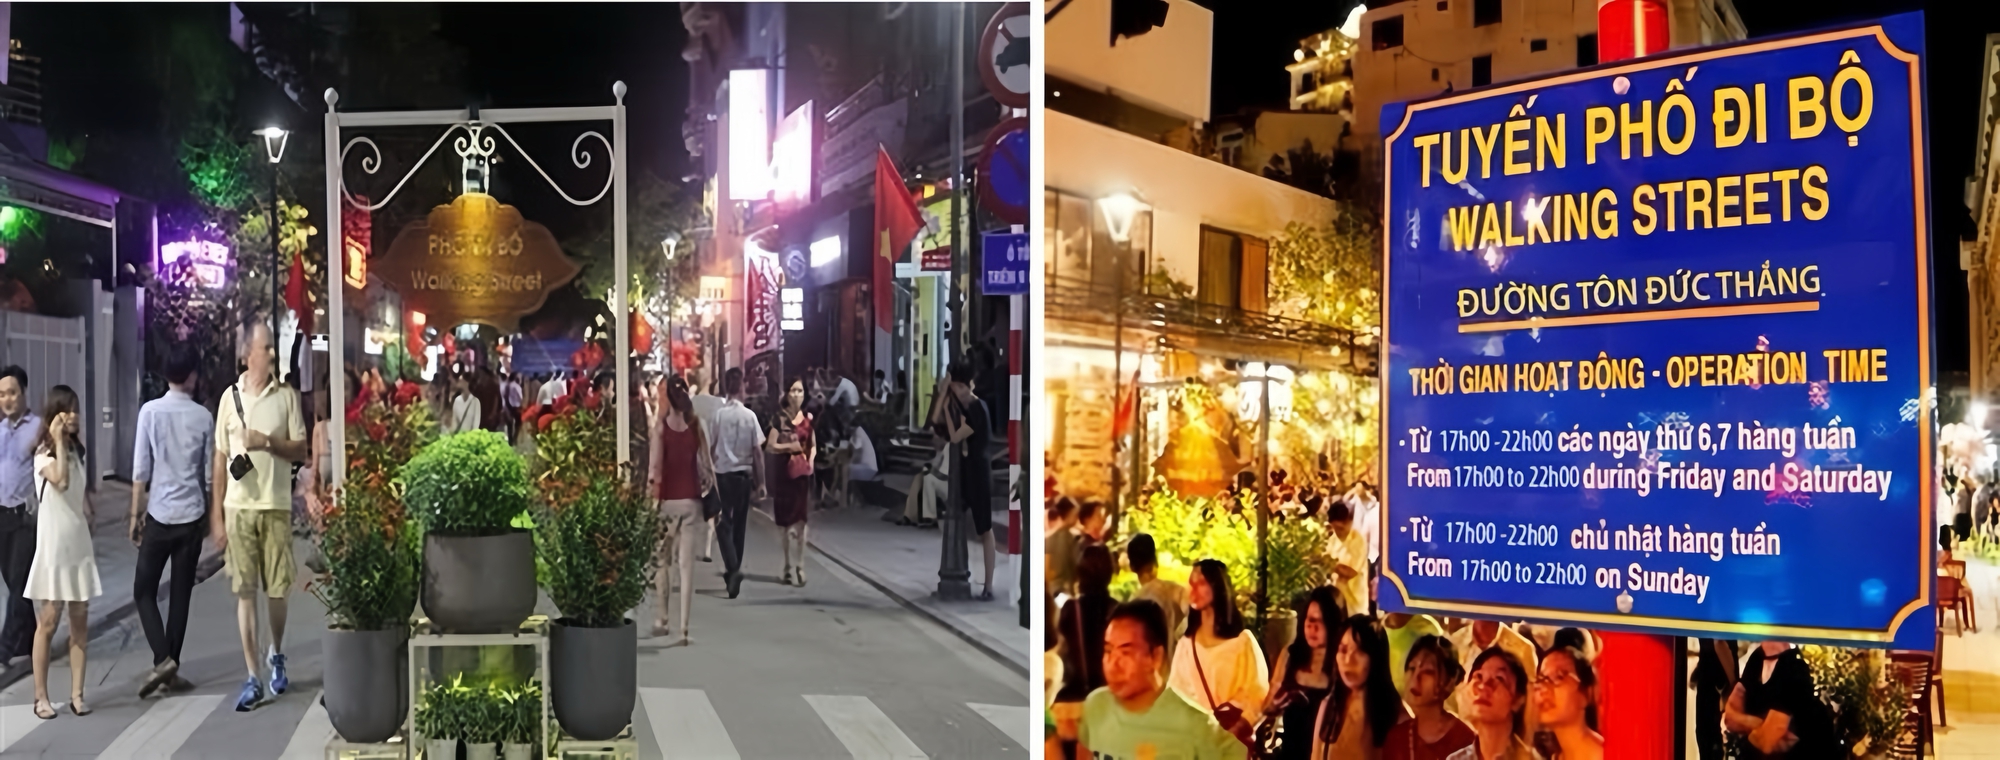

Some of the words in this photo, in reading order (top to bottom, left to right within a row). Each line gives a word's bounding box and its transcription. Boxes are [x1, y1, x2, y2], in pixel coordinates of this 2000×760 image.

[1413, 94, 1566, 188] TUYẾN
[1585, 66, 1698, 165] PHỐ
[1712, 83, 1767, 149] ĐI
[1788, 49, 1874, 147] BỘ
[1448, 188, 1619, 252] WALKING
[1631, 165, 1830, 236] STREETS
[1456, 280, 1571, 318] ĐƯỜNG
[1576, 273, 1638, 310] TÔN
[1645, 268, 1711, 305] ĐỨC
[1714, 259, 1821, 299] THẮNG
[1408, 357, 1454, 397] THỜI
[1459, 363, 1508, 394] GIAN
[1513, 360, 1573, 398] HOẠT
[1578, 351, 1645, 398] ĐỘNG
[1665, 351, 1808, 389] OPERATION
[1823, 348, 1889, 384] TIME
[1440, 429, 1490, 452] 17h00
[1557, 423, 1593, 452] các
[1599, 421, 1651, 459] ngày
[1697, 422, 1732, 456] 6,7
[1738, 419, 1796, 458] hàng
[1803, 415, 1856, 450] tuần
[1407, 462, 1451, 488] From
[1454, 465, 1504, 488] 17h00
[1508, 467, 1524, 488] to
[1528, 465, 1580, 488] 22h00
[1582, 462, 1650, 497] during
[1657, 461, 1726, 498] Friday
[1732, 462, 1776, 492] and
[1782, 462, 1893, 501] Saturday
[1445, 520, 1496, 545] 17h00
[1570, 518, 1610, 550] chủ
[1614, 523, 1663, 558] nhật
[1668, 523, 1724, 562] hàng
[1731, 521, 1781, 556] tuần
[1408, 551, 1452, 577] From
[1461, 558, 1512, 583] 17h00
[1515, 562, 1531, 583] to
[1535, 561, 1587, 586] 22h00
[1595, 567, 1621, 589] on
[1627, 562, 1711, 604] Sunday
